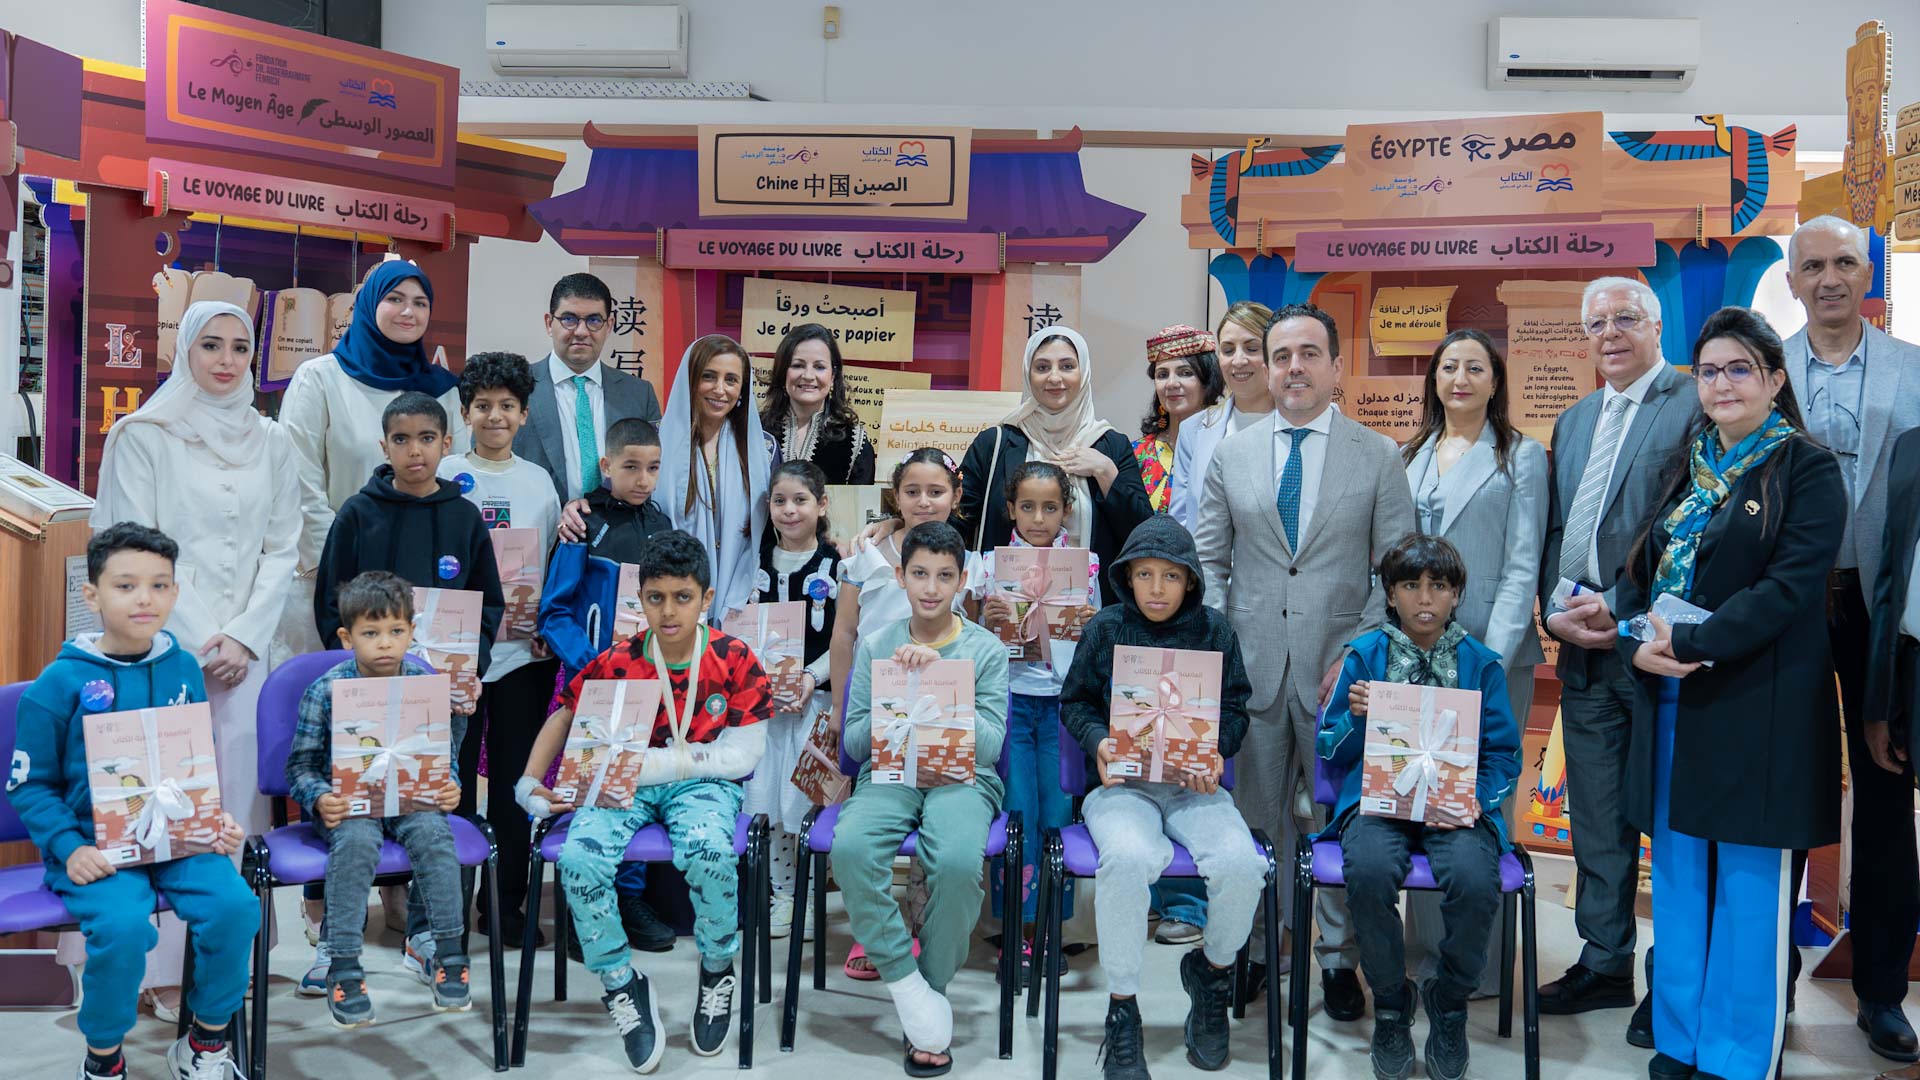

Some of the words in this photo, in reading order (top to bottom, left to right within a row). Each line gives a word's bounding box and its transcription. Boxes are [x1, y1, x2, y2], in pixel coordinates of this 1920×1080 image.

[256, 54, 288, 68] FONDATION
[188, 81, 206, 99] Le
[212, 87, 262, 113] Moyen
[267, 93, 294, 119] Âge
[319, 110, 381, 136] الوسطى
[384, 124, 434, 145] العصور
[862, 146, 892, 158] الكتاب
[1370, 135, 1452, 161] ÉGYPTE
[1498, 131, 1577, 160] مصر
[756, 176, 799, 190] Chine
[1500, 171, 1533, 184] الكتاب
[804, 174, 850, 198] 中国
[853, 177, 908, 196] الصين
[183, 177, 201, 194] LE
[205, 179, 261, 203] VOYAGE
[265, 188, 283, 206] DU
[287, 191, 325, 212] LIVRE
[335, 198, 388, 223] الكتاب
[392, 208, 428, 231] رحلة
[698, 241, 715, 255] LE
[719, 241, 775, 256] VOYAGE
[779, 242, 798, 256] DU
[802, 242, 843, 257] LIVRE
[921, 240, 964, 263] رحلة
[1327, 243, 1344, 257] LE
[1348, 242, 1406, 257] VOYAGE
[1410, 241, 1430, 256] DU
[1435, 240, 1478, 256] LIVRE
[1491, 236, 1558, 261] الكتاب
[1566, 232, 1614, 258] رحلة
[854, 242, 915, 264] الكتاب
[1379, 305, 1400, 314] لفافة
[1402, 305, 1415, 316] إلى
[1380, 319, 1393, 329] Je
[1409, 319, 1441, 328] déroule
[1523, 319, 1539, 327] لفافة
[757, 321, 776, 335] Je
[845, 327, 896, 344] papier
[277, 345, 294, 353] lettre
[1543, 364, 1569, 374] Égypte,
[1527, 375, 1534, 383] je
[853, 386, 873, 394] doux
[875, 387, 885, 395] et
[1393, 392, 1404, 403] له
[1535, 393, 1579, 402] hiéroglyphes
[854, 398, 871, 406] mon
[1357, 393, 1390, 405] مدلول
[1357, 408, 1389, 419] Chaque
[1391, 408, 1413, 419] signe
[889, 419, 935, 433] كلمات
[1393, 420, 1409, 428] une
[887, 439, 929, 449] Kalimat
[932, 440, 969, 451] Found
[688, 839, 710, 851] NIKE
[700, 851, 721, 862] AIR
